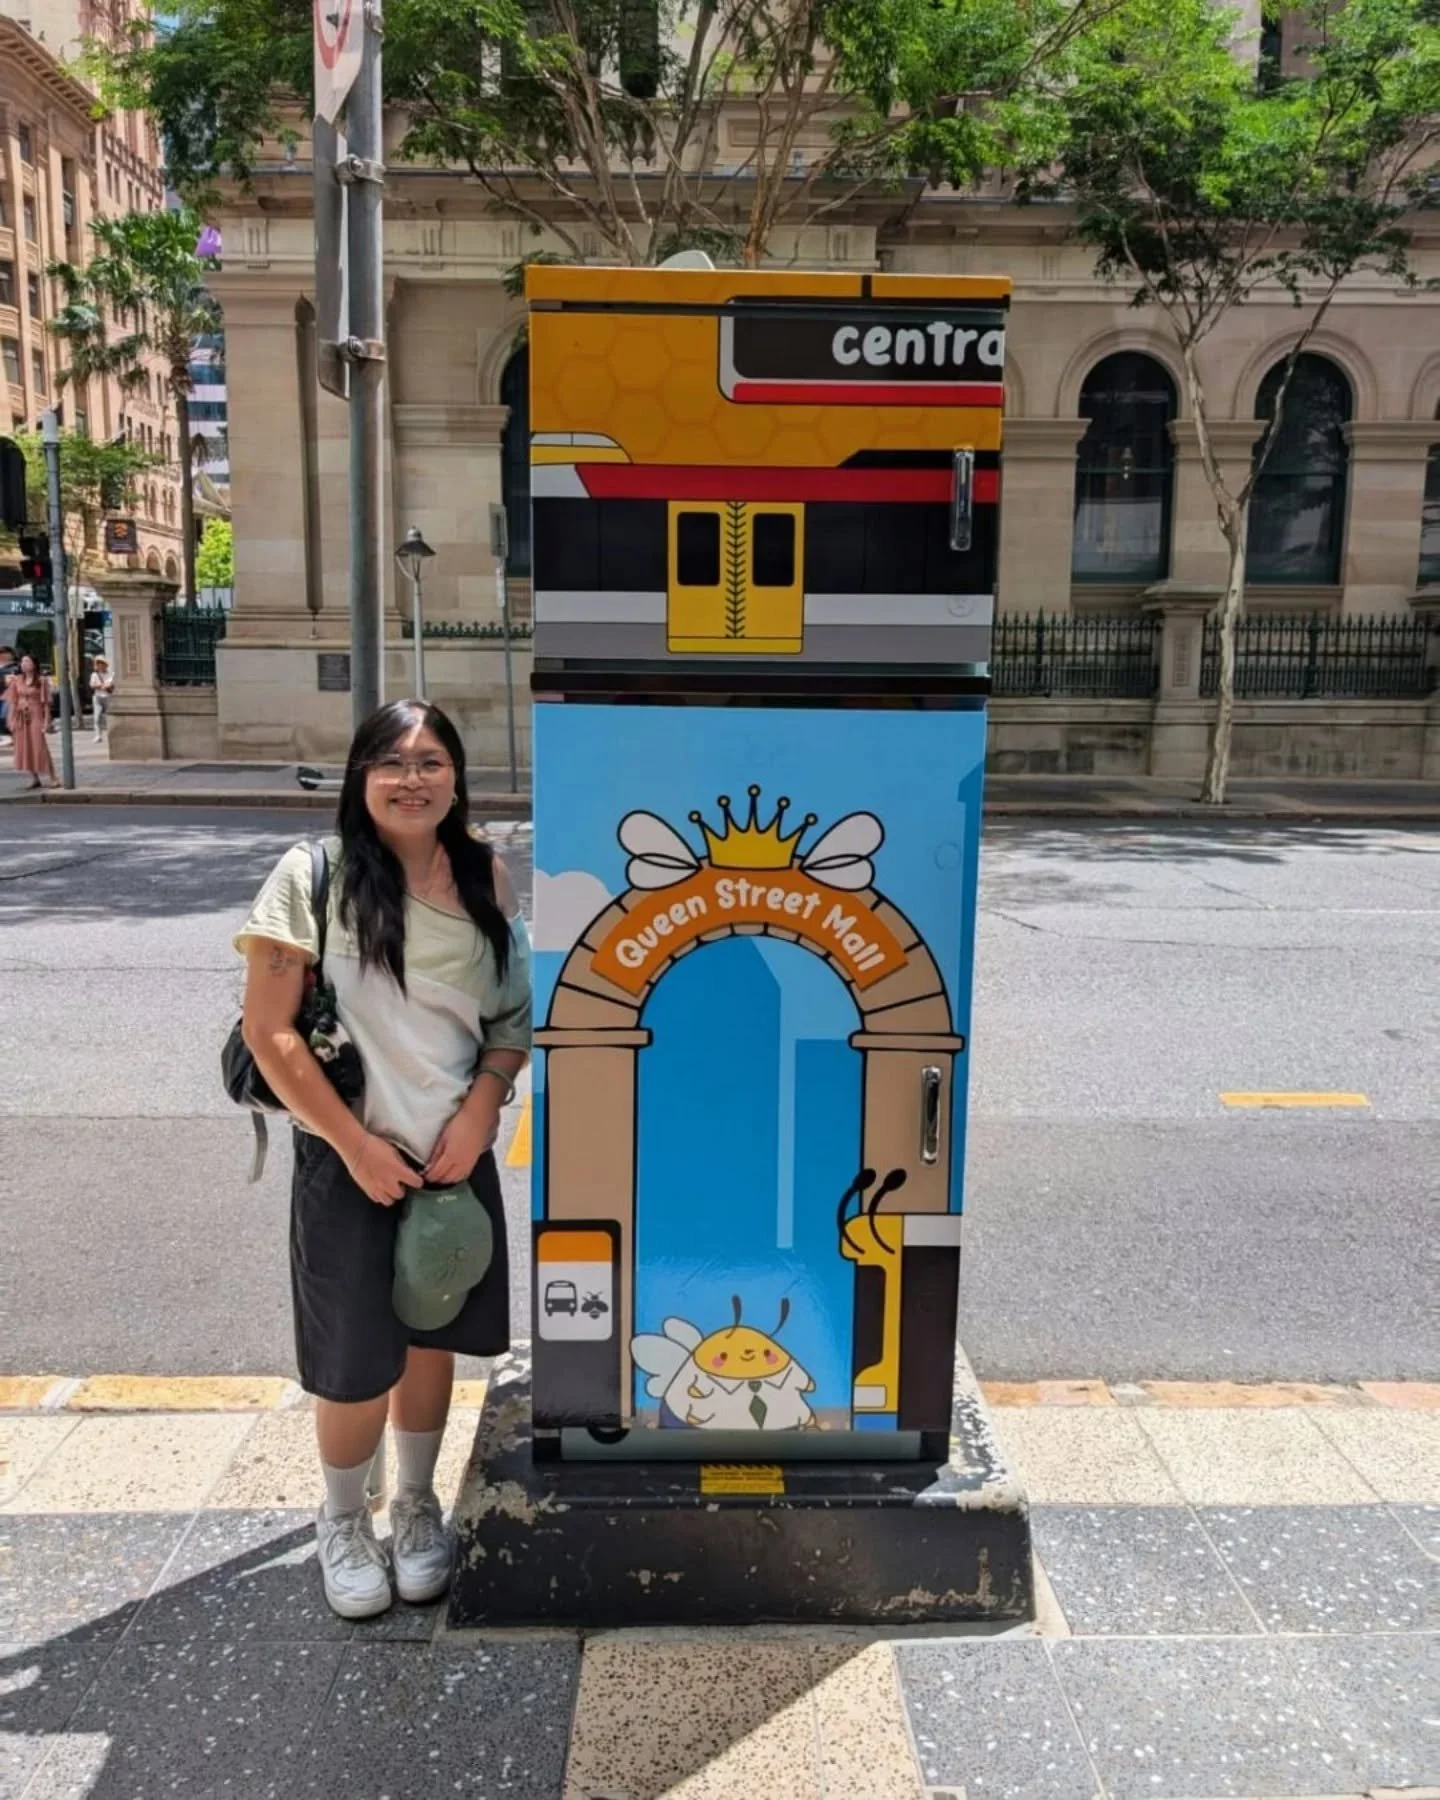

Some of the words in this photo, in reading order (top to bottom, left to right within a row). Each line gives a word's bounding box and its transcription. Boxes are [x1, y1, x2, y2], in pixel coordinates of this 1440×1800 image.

[615, 893, 708, 969] Queen
[714, 878, 822, 920] Street
[821, 904, 887, 972] Mall
